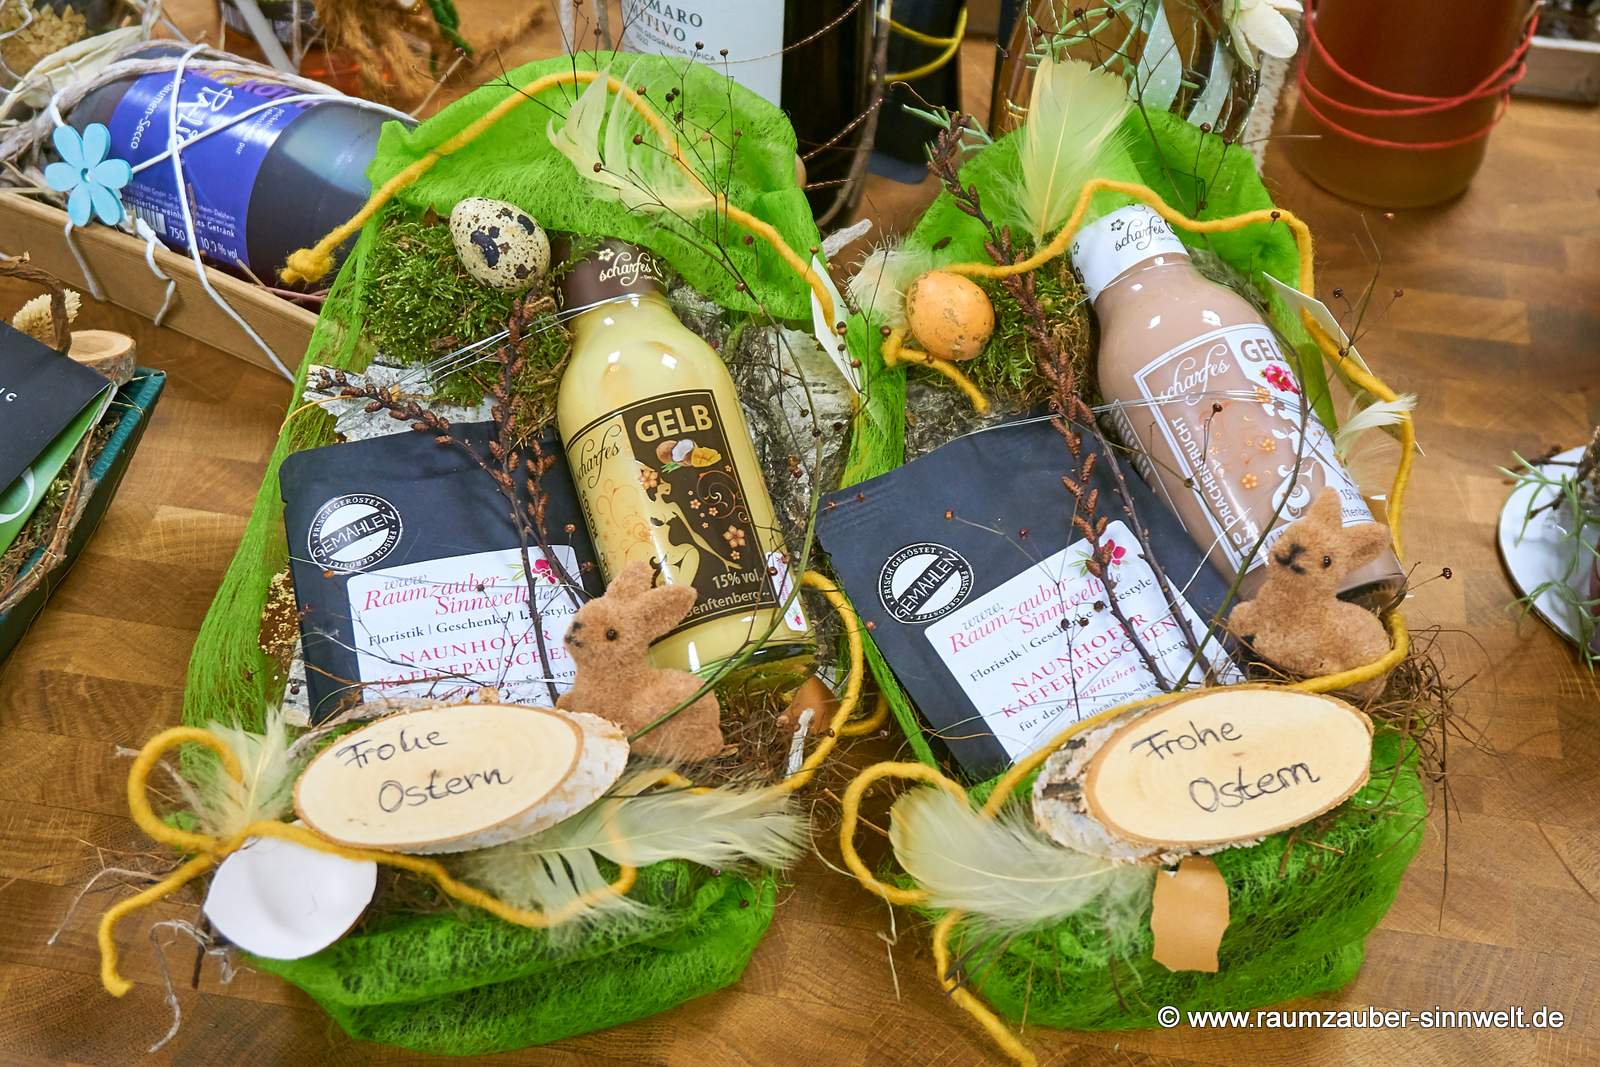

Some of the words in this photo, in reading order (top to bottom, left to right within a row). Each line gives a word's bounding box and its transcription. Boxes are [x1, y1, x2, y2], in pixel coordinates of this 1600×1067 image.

[642, 0, 703, 28] MARO
[690, 49, 716, 61] TPICA
[169, 226, 186, 241] 750
[1115, 216, 1165, 252] scharfes
[600, 252, 652, 286] scharfes
[1240, 338, 1283, 363] GEL
[635, 404, 713, 443] GELB
[576, 424, 622, 489] charfes
[313, 510, 397, 558] GEMAHLEN
[363, 572, 507, 612] Raumzauber-
[712, 571, 741, 590] 15%
[883, 567, 895, 600] FRISCH
[891, 546, 937, 567] GERÖSTET
[895, 552, 960, 619] GEMAHLEN
[369, 627, 425, 647] Floristik
[436, 612, 508, 634] Geschenke
[949, 576, 1076, 654] Raumzauber-
[970, 646, 1023, 683] Floristik
[1019, 716, 1039, 732] für
[1042, 704, 1065, 722] den
[1066, 665, 1137, 710] gmütlichen
[336, 729, 449, 769] Frohe
[1129, 720, 1243, 760] Frohe
[379, 768, 514, 813] Ostern
[1189, 762, 1321, 813] Ostern
